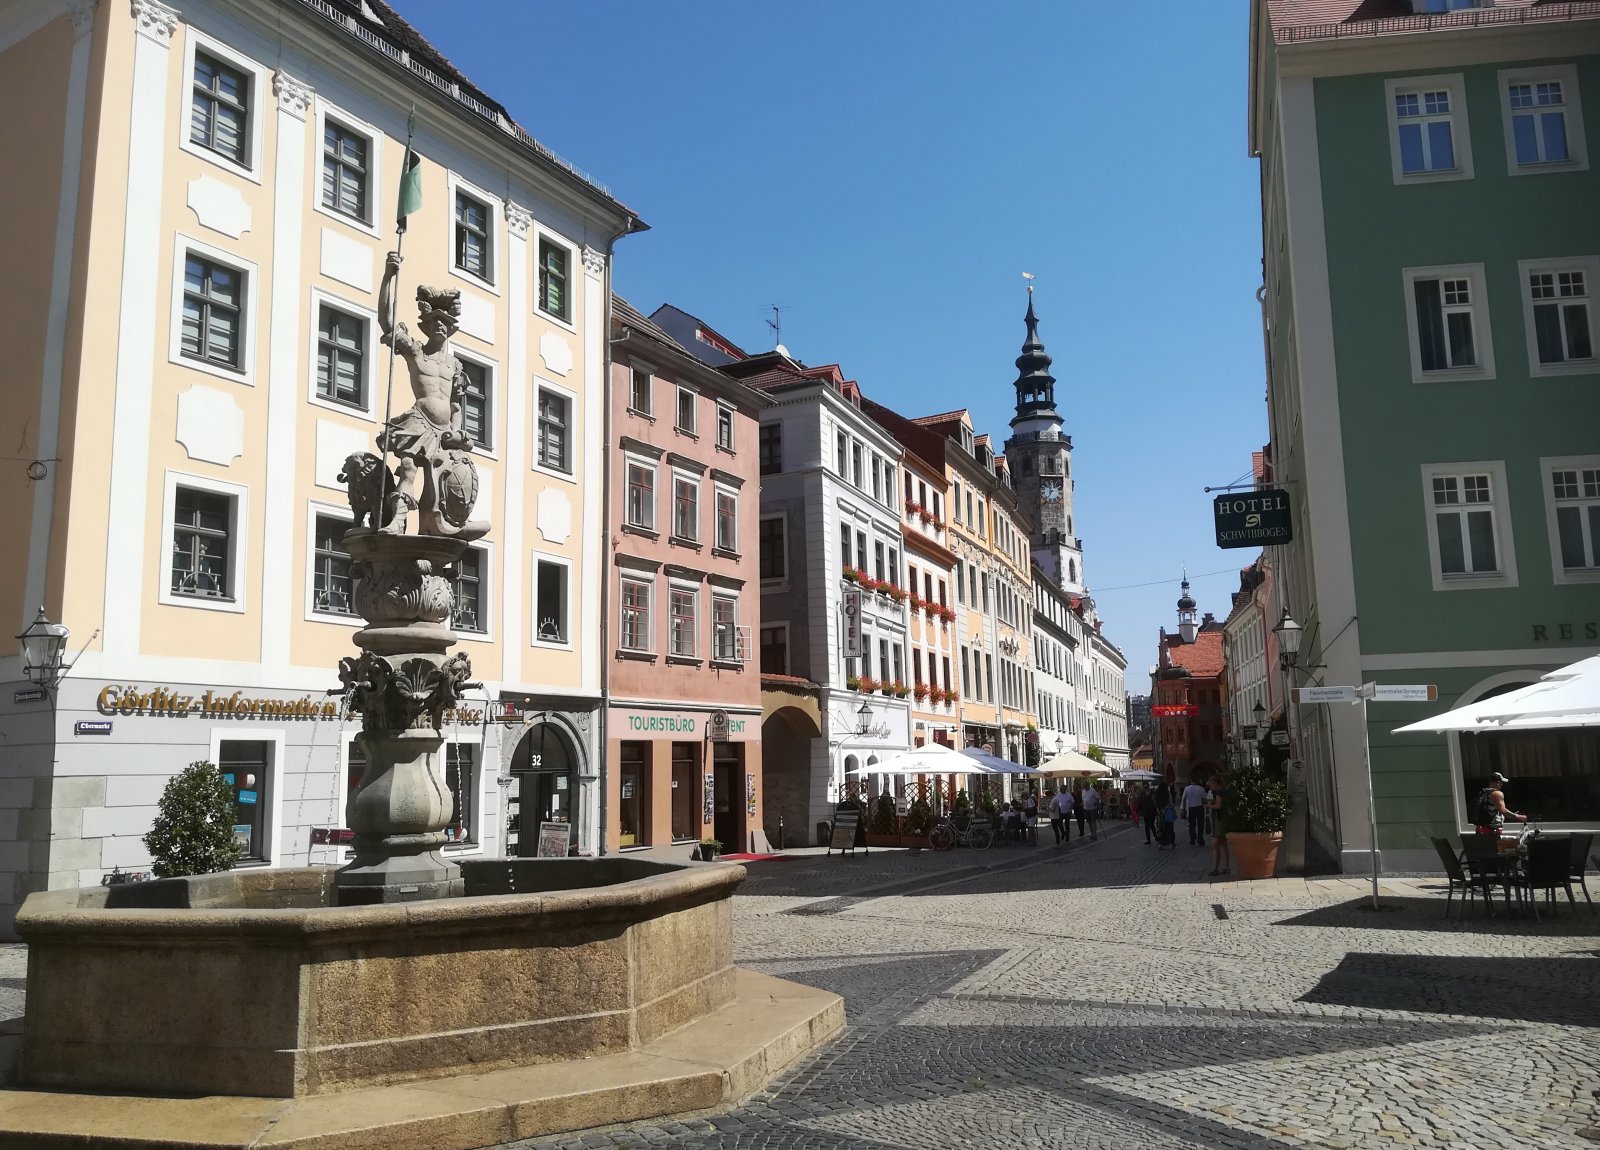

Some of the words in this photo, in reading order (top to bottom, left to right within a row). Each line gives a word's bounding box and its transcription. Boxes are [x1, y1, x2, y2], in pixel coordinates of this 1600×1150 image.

[1218, 497, 1287, 515] HOTEL
[1220, 527, 1289, 541] SCHWIBBOGEN
[845, 594, 857, 650] HOTEL
[1532, 622, 1599, 641] RES
[99, 684, 338, 716] Görlitz-Information
[80, 722, 111, 730] Obermarkt
[628, 715, 695, 732] TOURISTBÜRO
[532, 755, 542, 766] 32
